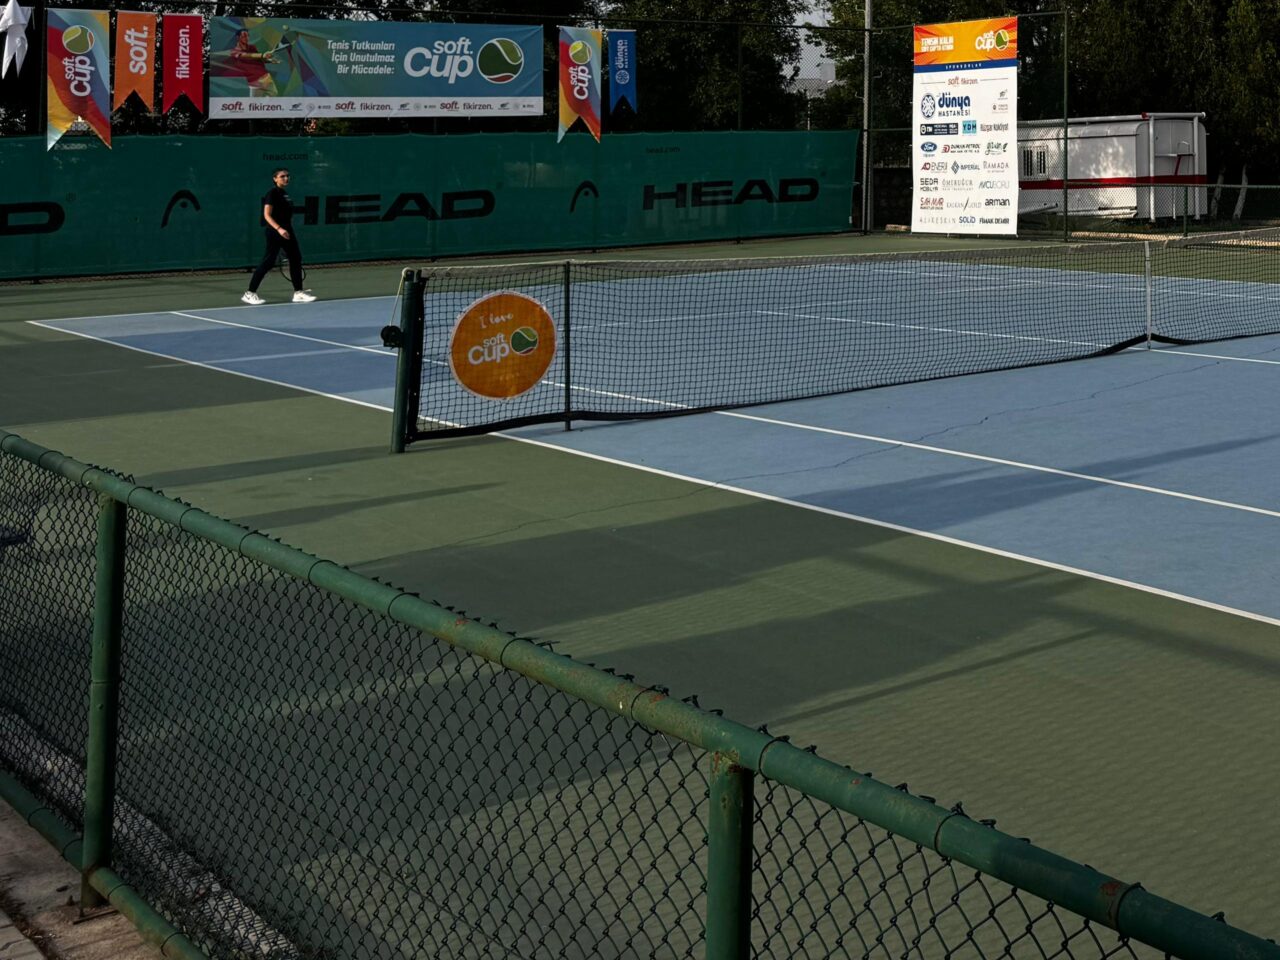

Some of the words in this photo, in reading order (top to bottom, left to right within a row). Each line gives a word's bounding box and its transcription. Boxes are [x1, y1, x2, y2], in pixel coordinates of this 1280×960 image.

[125, 25, 149, 75] soft.
[176, 25, 190, 79] fikirzen.
[351, 40, 395, 51] Tutkunları
[433, 37, 474, 55] soft.
[331, 51, 348, 64] İçin
[349, 52, 395, 63] Unutulmaz
[403, 46, 474, 84] Cup
[70, 55, 95, 97] Cup
[337, 64, 349, 74] Bir
[351, 63, 395, 75] Mücadele:
[573, 65, 592, 100] Cup
[248, 102, 284, 111] fikirzen.
[938, 92, 971, 110] dünya
[642, 178, 819, 211] HEAD
[467, 343, 510, 365] Cup
